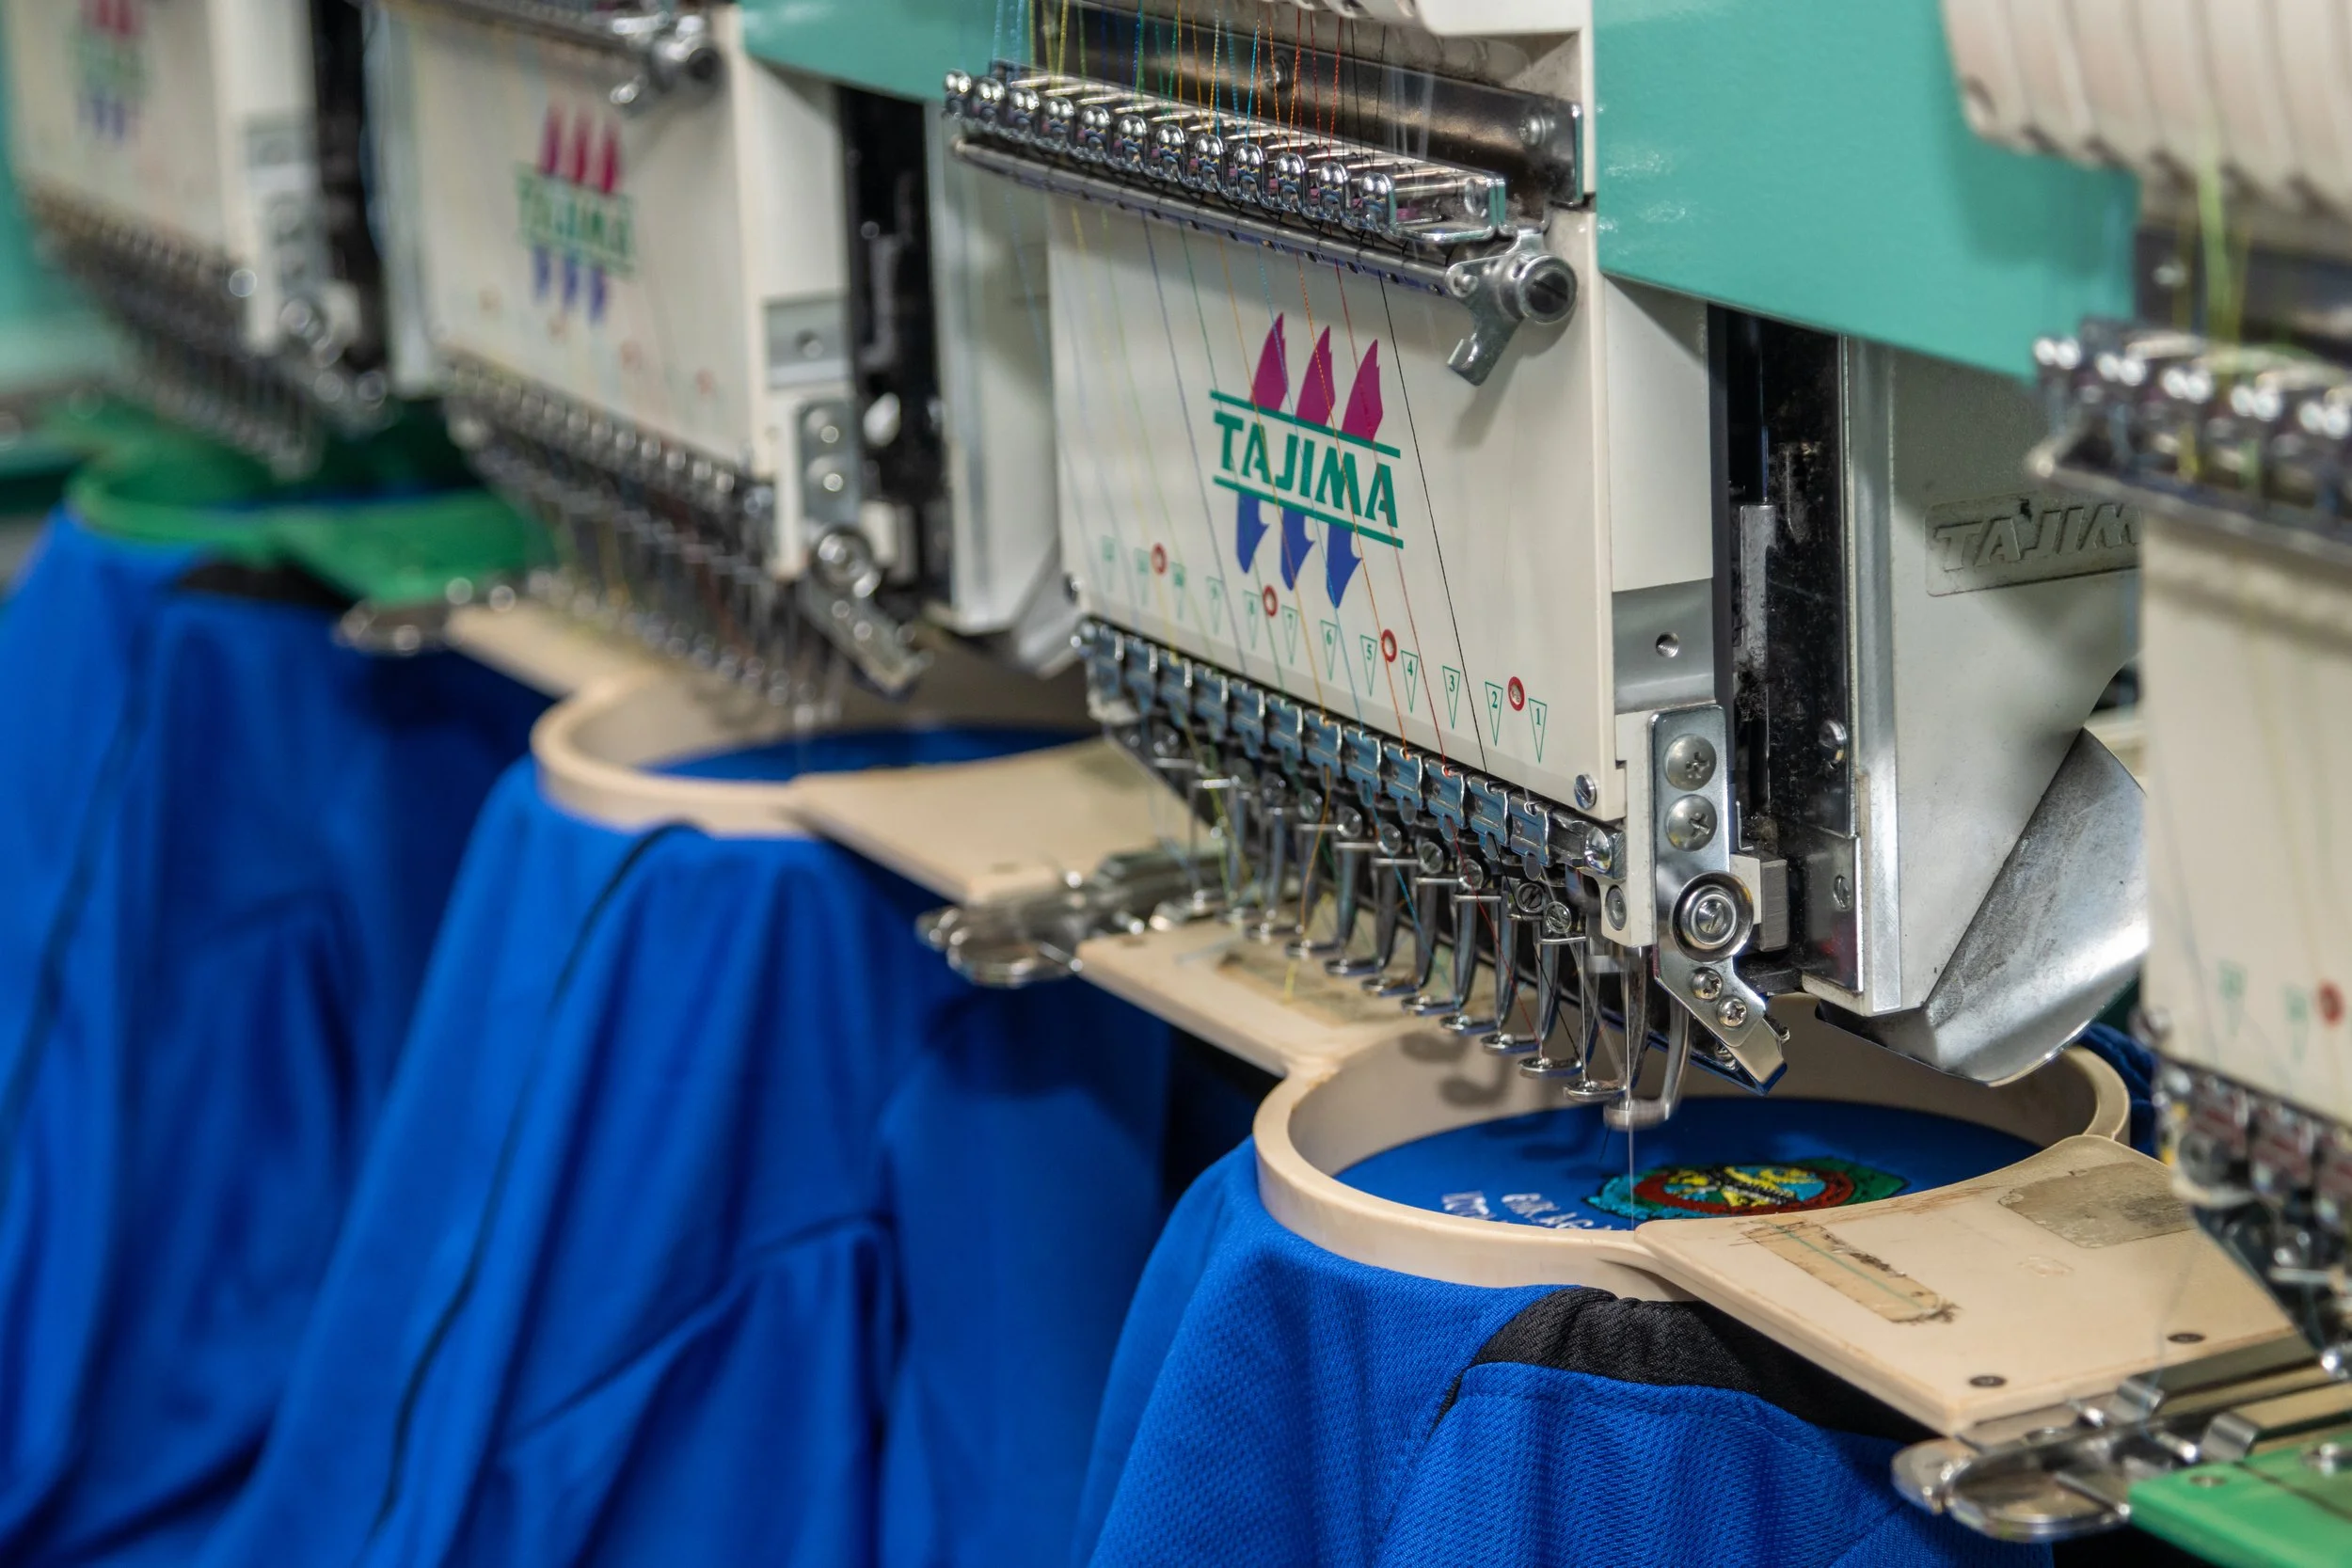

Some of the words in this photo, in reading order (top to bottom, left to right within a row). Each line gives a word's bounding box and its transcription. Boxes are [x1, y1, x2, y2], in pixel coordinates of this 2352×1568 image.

[1214, 409, 1399, 529] TAJIMA
[1933, 502, 2142, 572] TAJIM
[1286, 611, 1295, 629] 7
[1326, 628, 1333, 645] 6
[1365, 642, 1373, 660] 5
[1406, 659, 1414, 676] 4
[1448, 673, 1456, 692] 3
[1491, 690, 1500, 709] 2
[1534, 707, 1542, 725] 1
